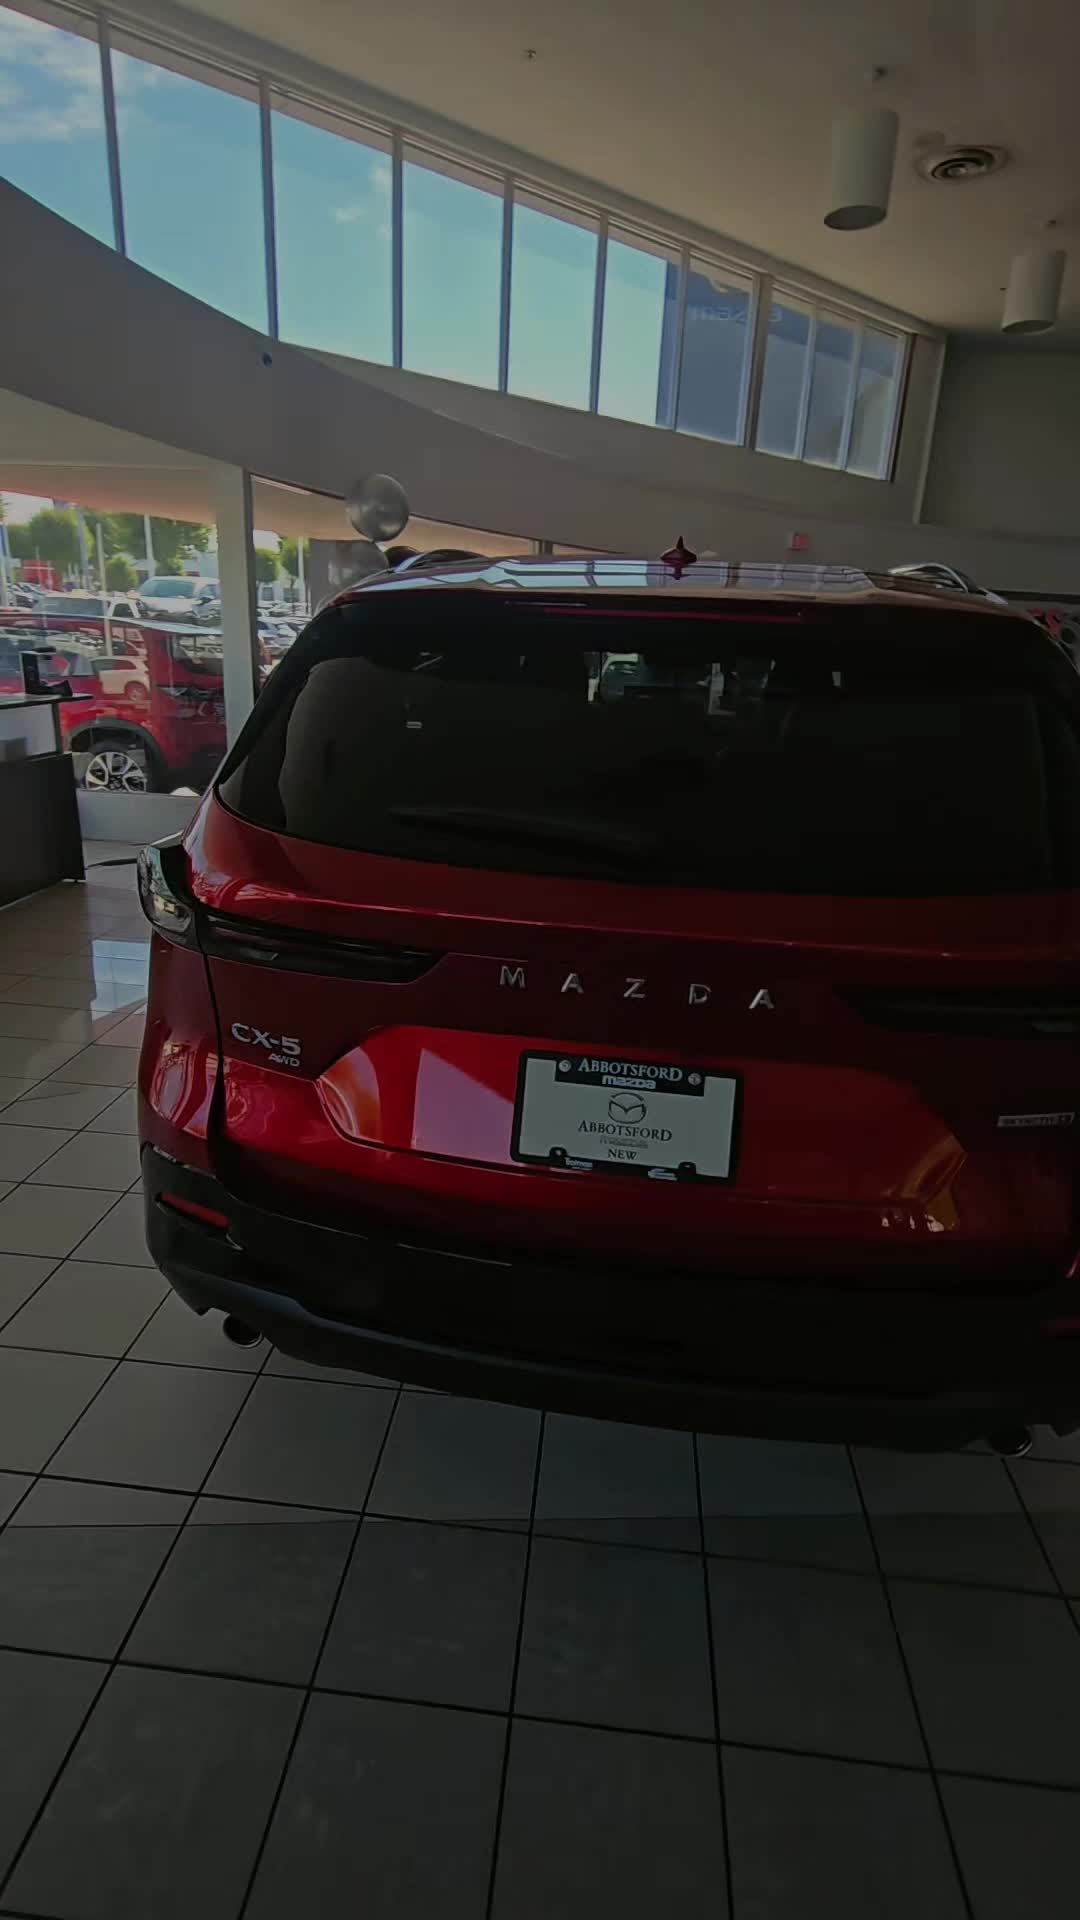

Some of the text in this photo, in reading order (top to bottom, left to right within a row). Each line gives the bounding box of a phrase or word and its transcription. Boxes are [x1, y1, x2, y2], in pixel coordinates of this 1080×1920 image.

[499, 964, 776, 1010] MAZDA
[231, 1022, 302, 1056] CX-5
[268, 1052, 301, 1067] AWD
[577, 1057, 684, 1082] ABBOTSFORD
[577, 1119, 673, 1142] ABBOTSFORD
[607, 1148, 638, 1161] NEW
